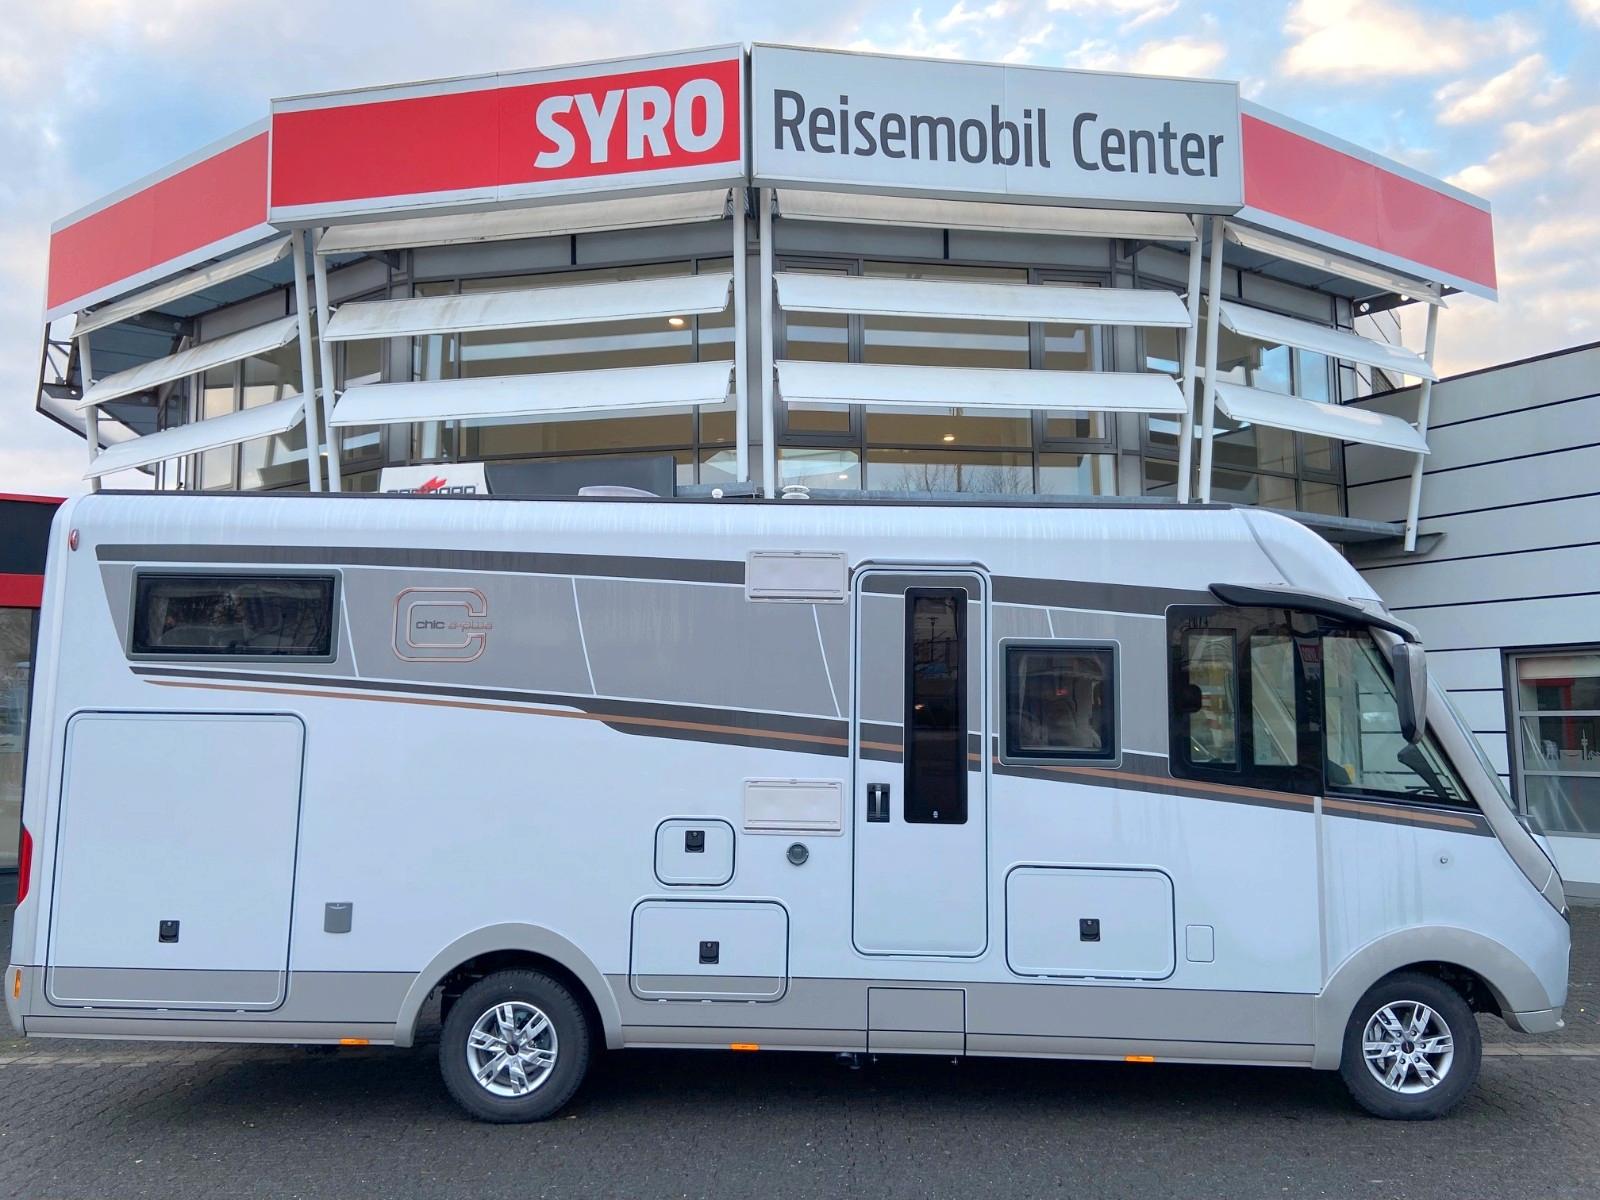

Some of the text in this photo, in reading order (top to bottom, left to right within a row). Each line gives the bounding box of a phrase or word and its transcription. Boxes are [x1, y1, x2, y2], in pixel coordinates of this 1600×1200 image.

[533, 78, 725, 169] SYRO
[774, 89, 1224, 177] Reisemobil Center
[416, 620, 445, 630] chic
